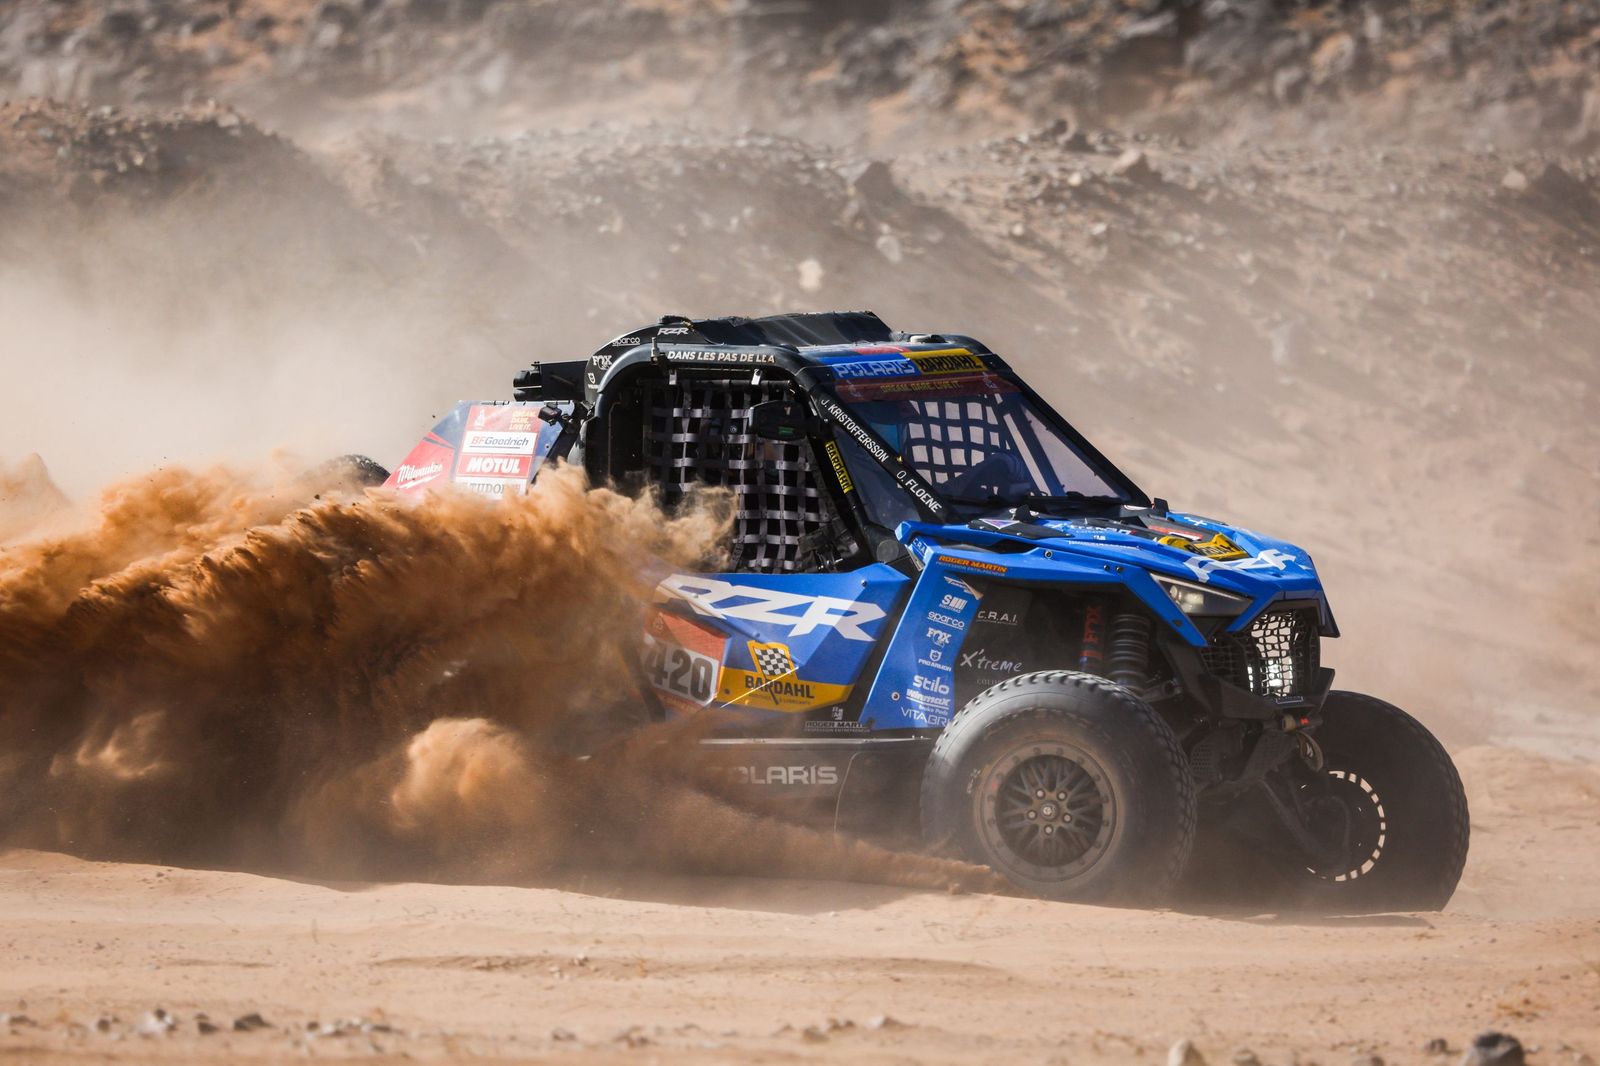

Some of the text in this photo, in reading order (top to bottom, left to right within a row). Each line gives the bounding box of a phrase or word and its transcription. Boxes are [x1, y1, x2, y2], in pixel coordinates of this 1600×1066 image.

[657, 327, 689, 336] RZR
[667, 351, 695, 360] DANS
[697, 352, 716, 361] LES
[717, 352, 738, 362] PAS
[740, 353, 754, 362] DE
[832, 361, 915, 377] POLARIS
[820, 399, 889, 463] J. KRISTOFFERSSON
[471, 436, 529, 447] BFGoodrich
[397, 463, 443, 484] Milwaukee
[467, 458, 521, 473] MOTUL
[827, 443, 853, 493] BARDAHL
[896, 470, 942, 513] O. FLOENE
[938, 555, 1008, 573] ROGER MARTIN
[656, 574, 887, 641] RZR
[977, 610, 1018, 624] C.R.A.I.
[928, 611, 965, 628] sparco
[926, 627, 952, 647] FOX
[645, 645, 713, 702] 420
[745, 675, 815, 698] BARDAHL
